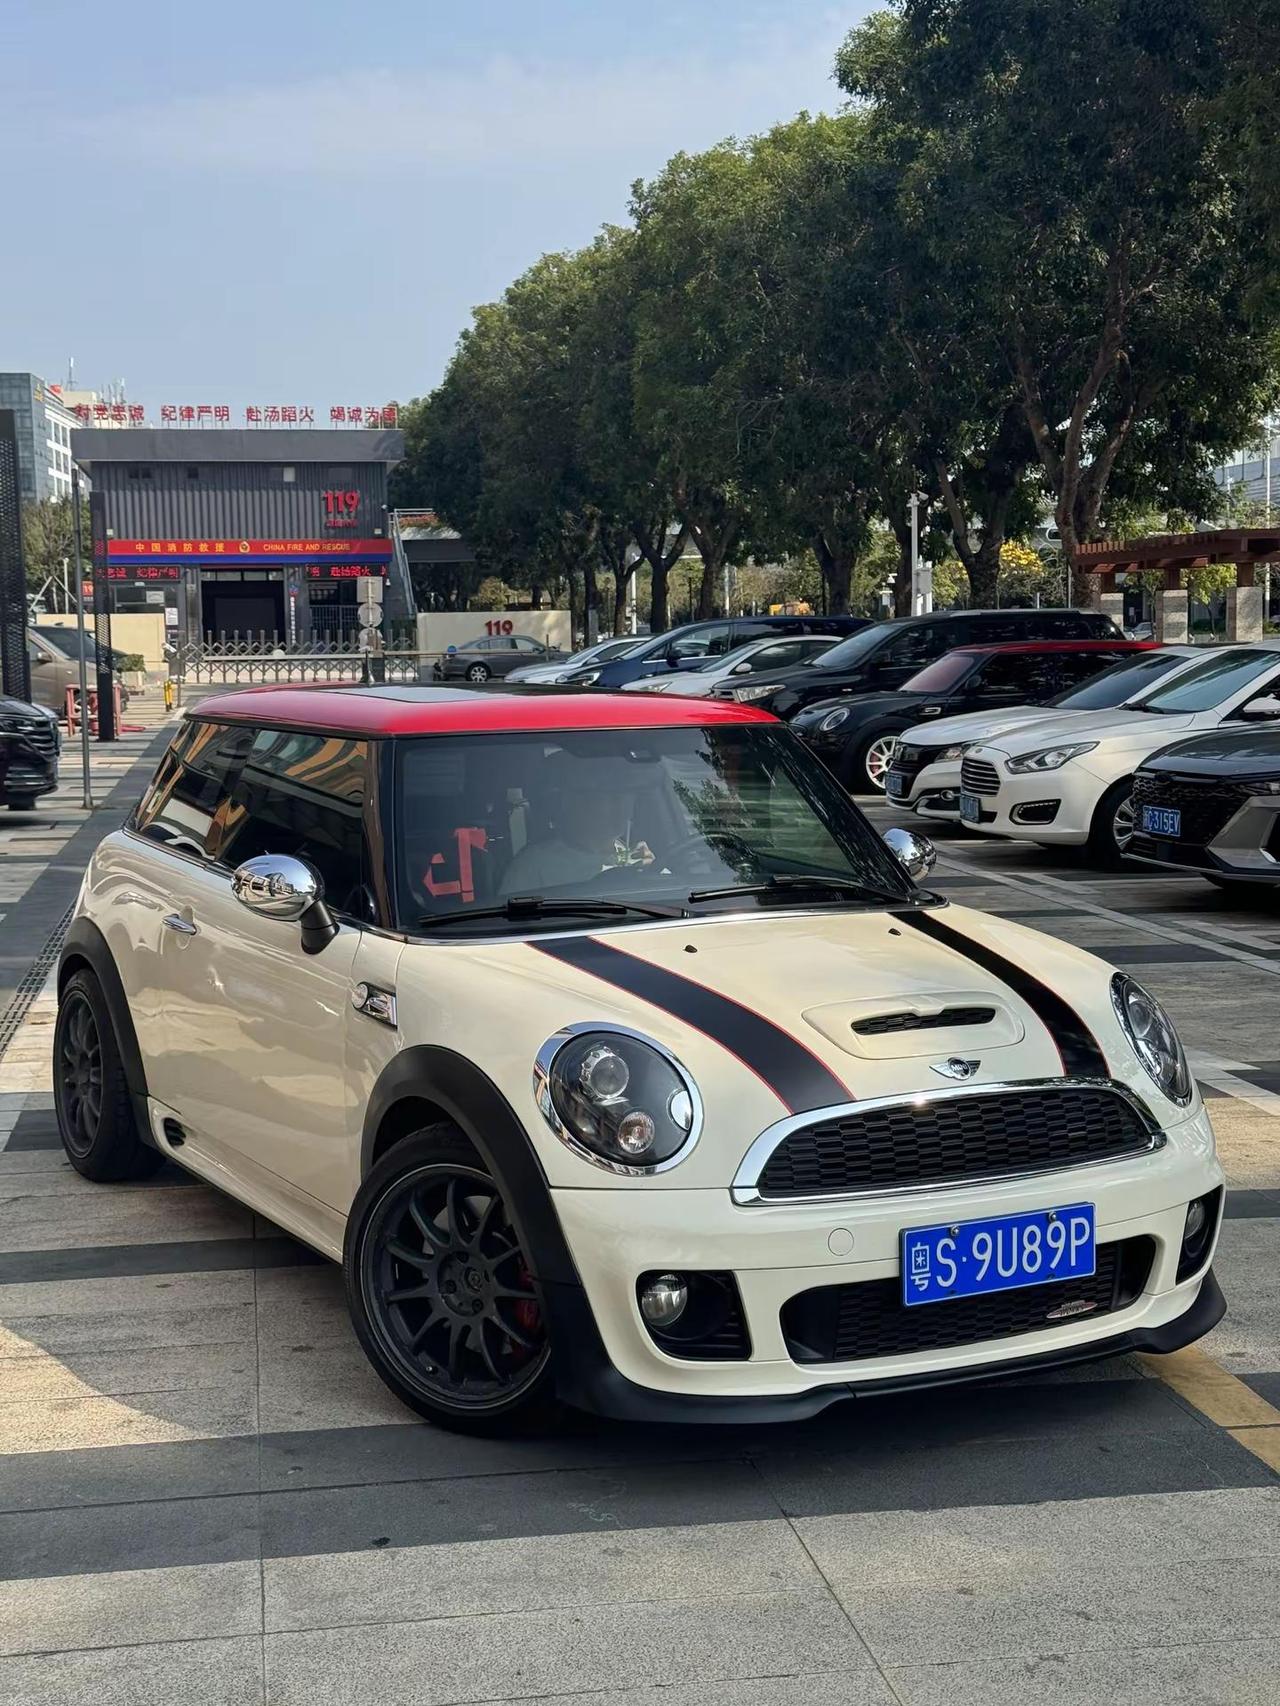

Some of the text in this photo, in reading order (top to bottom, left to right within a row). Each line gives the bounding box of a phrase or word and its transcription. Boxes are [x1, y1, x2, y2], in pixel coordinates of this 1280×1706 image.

[161, 405, 229, 421] 纪律严明
[247, 406, 314, 422] 赴汤蹈火
[325, 490, 359, 513] 119
[136, 542, 225, 553] 中国消防救援
[263, 543, 350, 551] CHINA FIRE AND RESCUE
[485, 620, 513, 636] 119
[910, 1217, 1090, 1292] 粤S·9U89P
